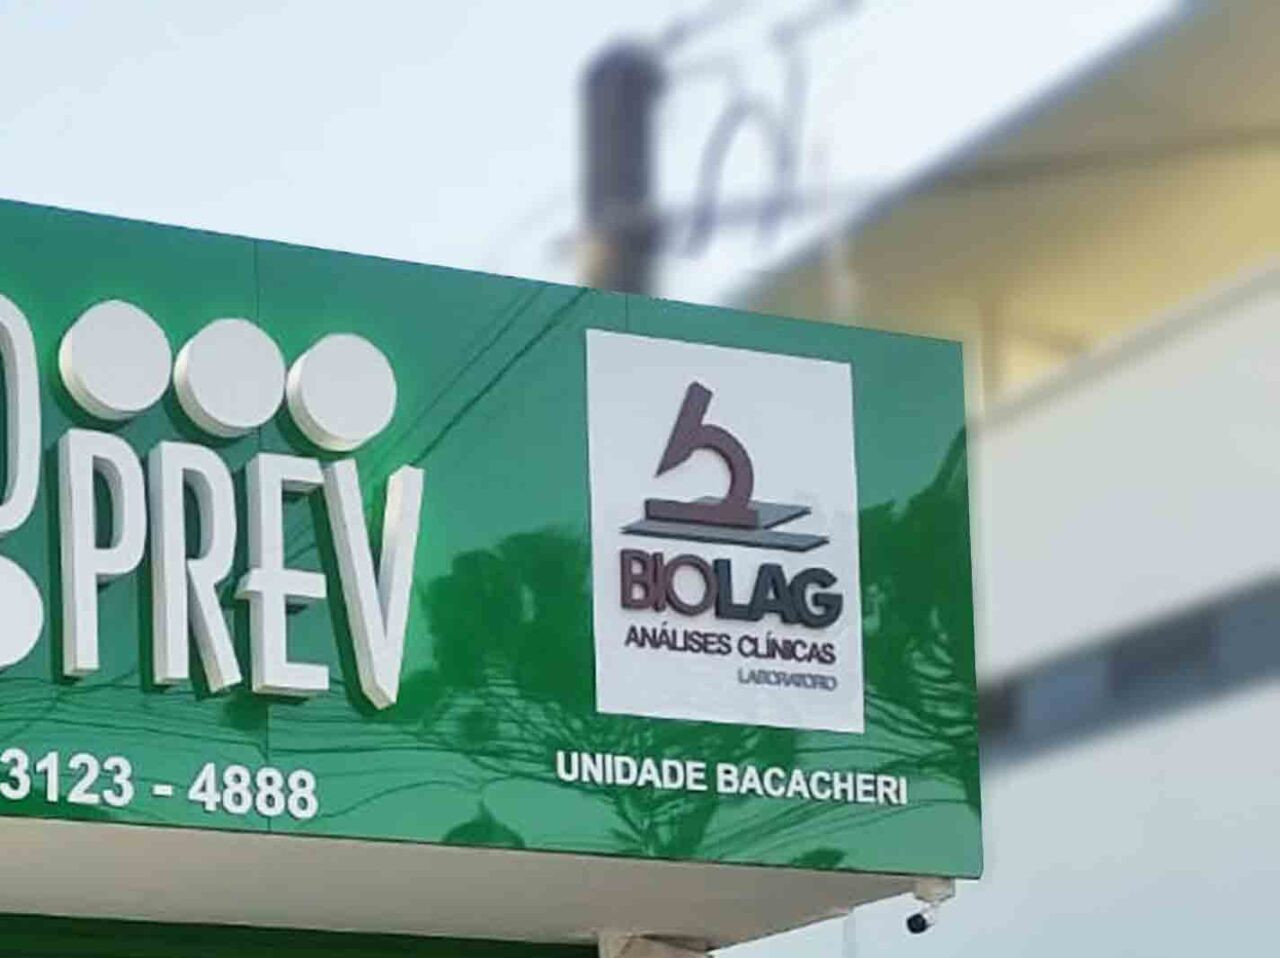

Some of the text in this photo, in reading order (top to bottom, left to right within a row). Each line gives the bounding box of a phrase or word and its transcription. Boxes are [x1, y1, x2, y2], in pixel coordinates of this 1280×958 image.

[59, 428, 425, 712] PREV
[619, 548, 844, 629] BIOLAG
[624, 621, 837, 665] ANÁLISES CLÍNICAS
[0, 748, 134, 807] 3123
[188, 762, 319, 819] 4888
[556, 750, 908, 805] UNIDADE BACACHERI
